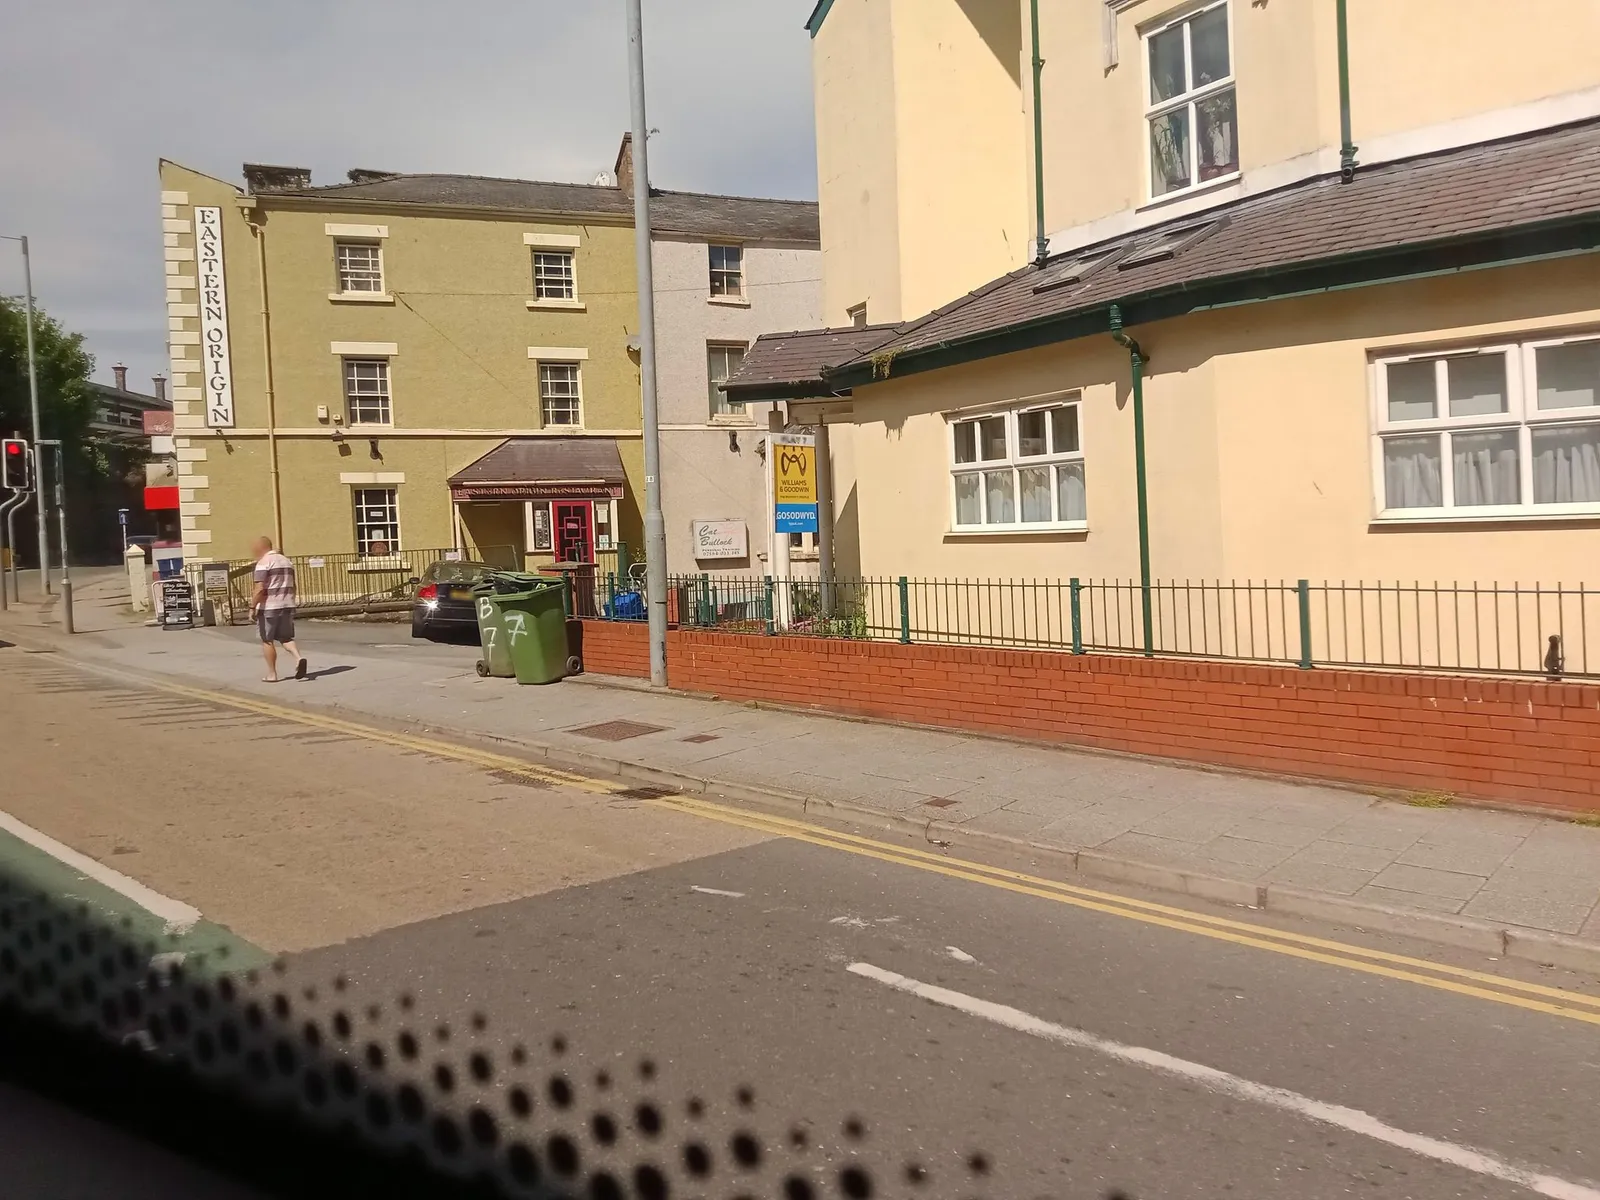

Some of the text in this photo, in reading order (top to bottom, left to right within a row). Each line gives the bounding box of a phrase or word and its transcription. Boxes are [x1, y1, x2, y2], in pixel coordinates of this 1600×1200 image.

[200, 209, 229, 422] EASTERN ORIGIN
[699, 525, 717, 536] Cat
[700, 536, 732, 546] Bullock
[483, 627, 497, 660] 7
[504, 614, 528, 646] 7
